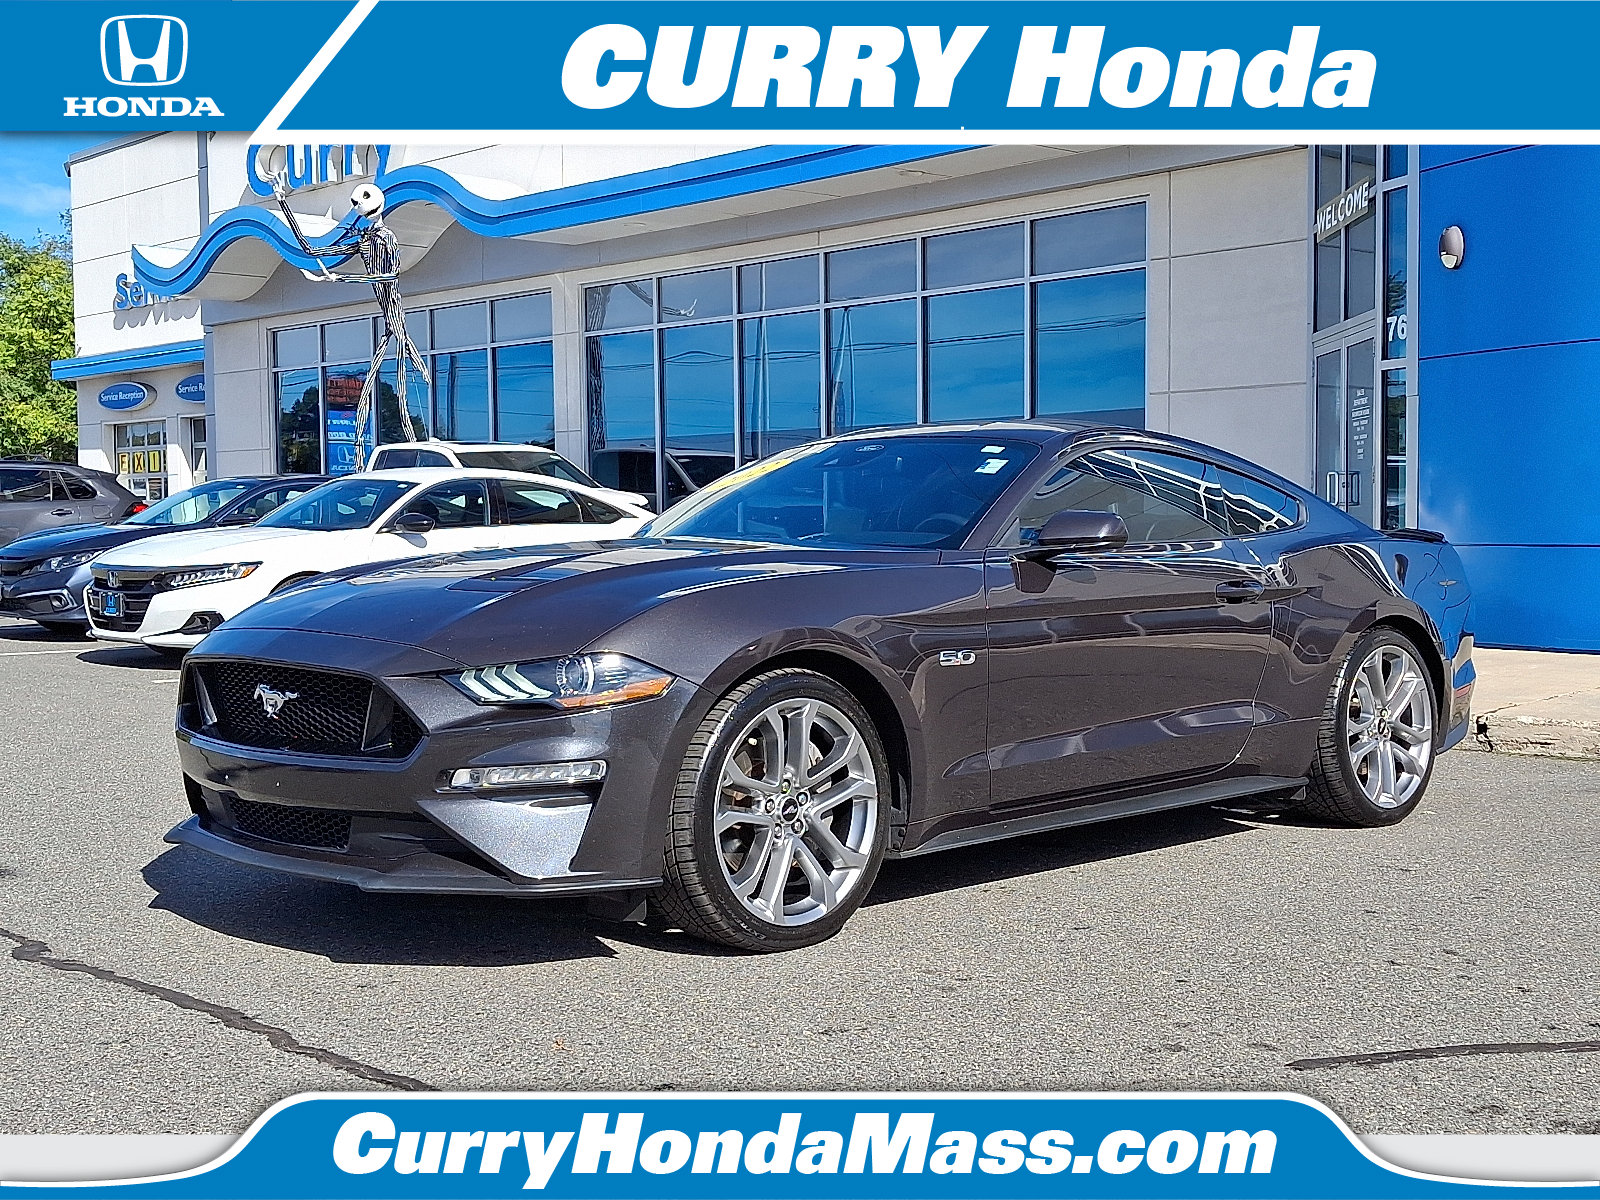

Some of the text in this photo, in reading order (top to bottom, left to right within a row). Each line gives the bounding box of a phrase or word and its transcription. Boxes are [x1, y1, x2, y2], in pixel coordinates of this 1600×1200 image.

[1317, 181, 1369, 234] WELCOME
[101, 390, 144, 402] Service Reception
[178, 384, 198, 394] Service
[120, 453, 156, 472] EXI
[940, 649, 976, 667] 5.0
